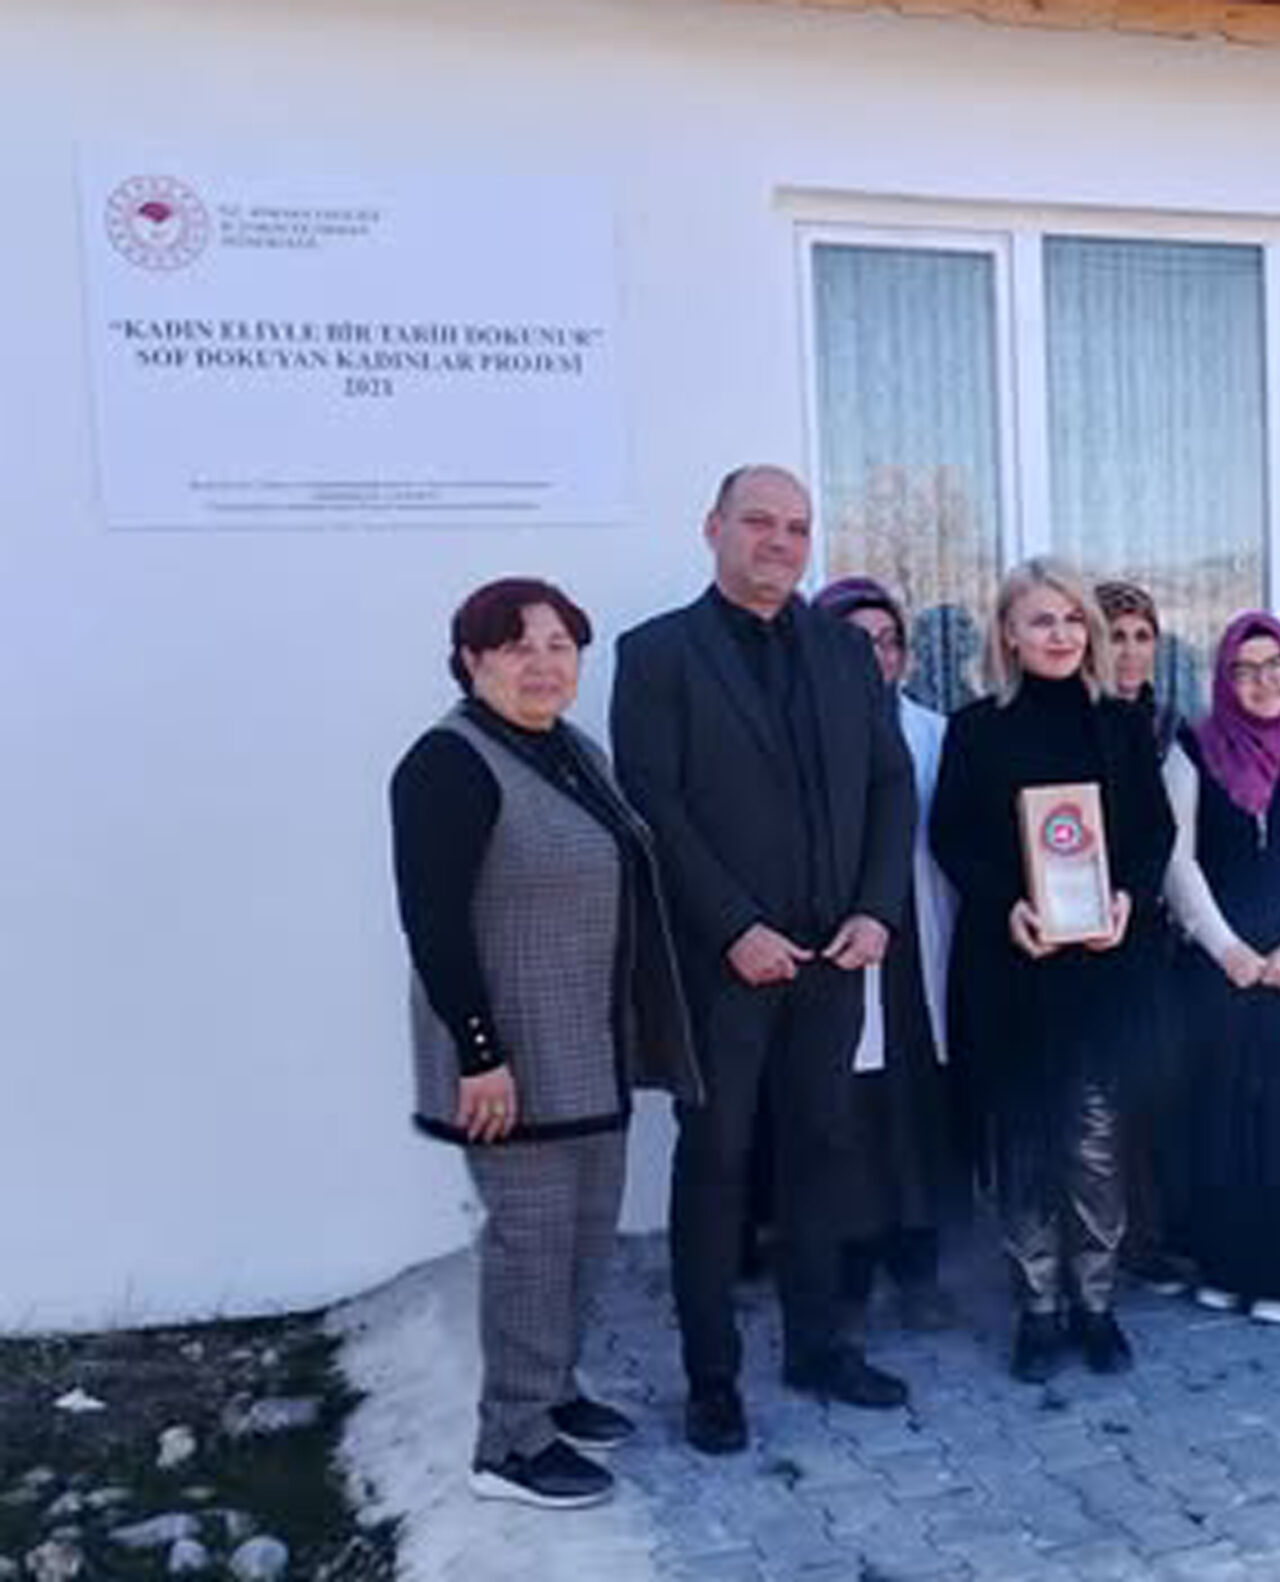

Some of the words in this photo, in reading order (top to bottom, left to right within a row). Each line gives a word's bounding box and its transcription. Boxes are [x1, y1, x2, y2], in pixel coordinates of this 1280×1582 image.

[136, 348, 188, 367] SOF
[194, 349, 328, 370] DOKUYAN
[335, 350, 475, 372] KADINLAR
